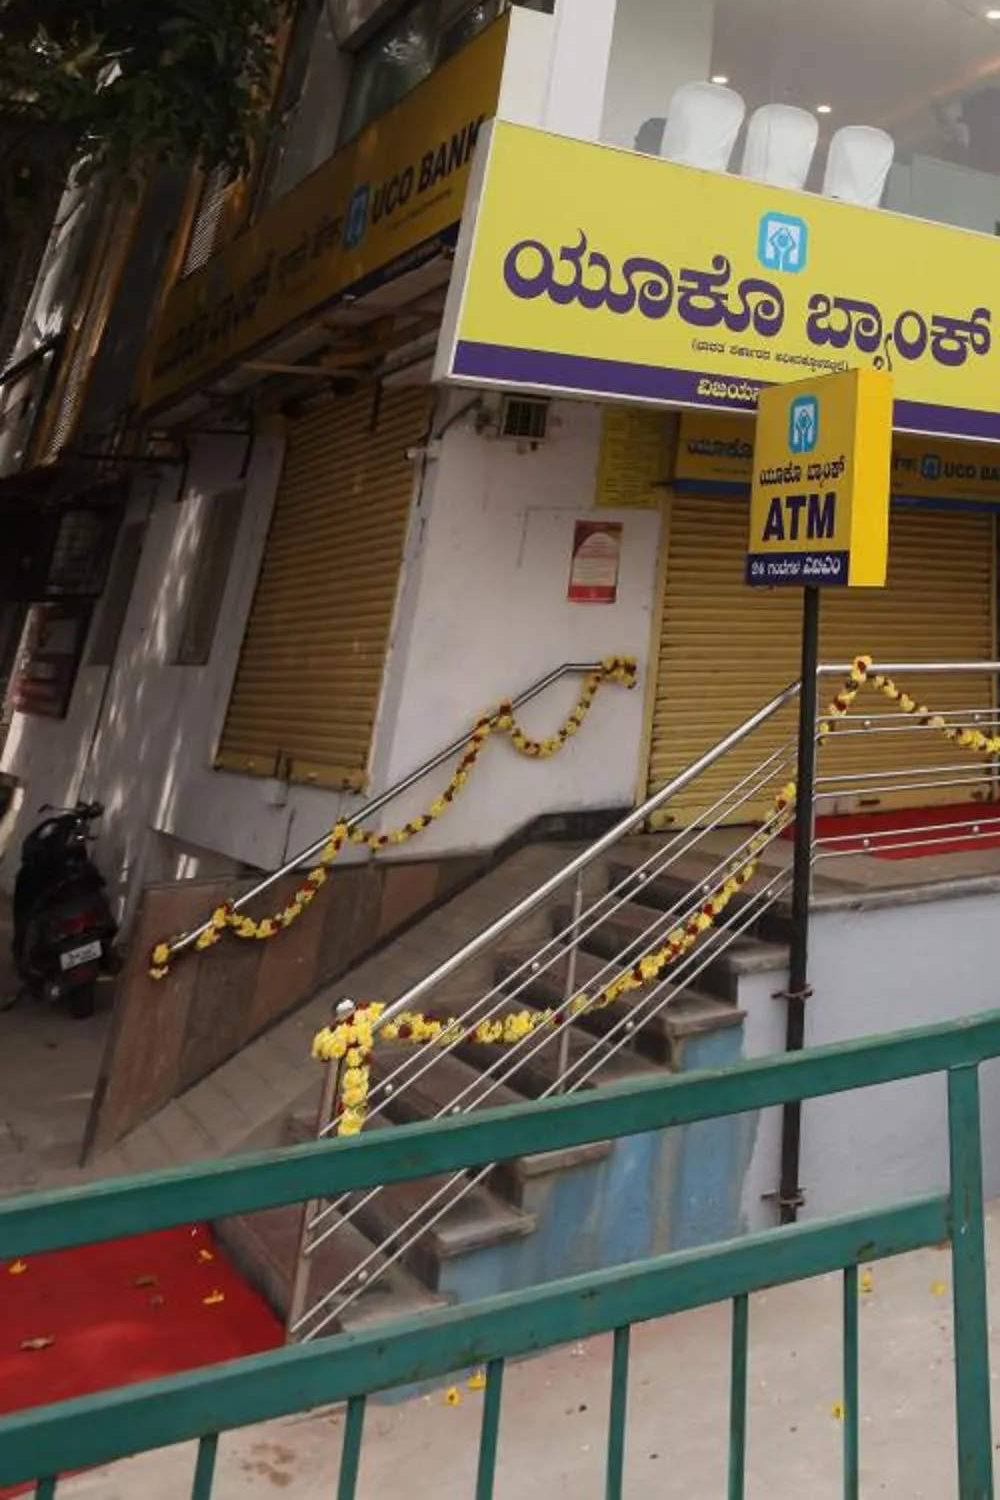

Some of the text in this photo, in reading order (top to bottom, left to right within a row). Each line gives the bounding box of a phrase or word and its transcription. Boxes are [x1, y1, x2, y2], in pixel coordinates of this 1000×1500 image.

[372, 165, 416, 224] UCO
[806, 293, 992, 371] ಬ್ಯಾಂಕ್
[944, 460, 976, 479] UCO
[762, 492, 836, 542] ATM
